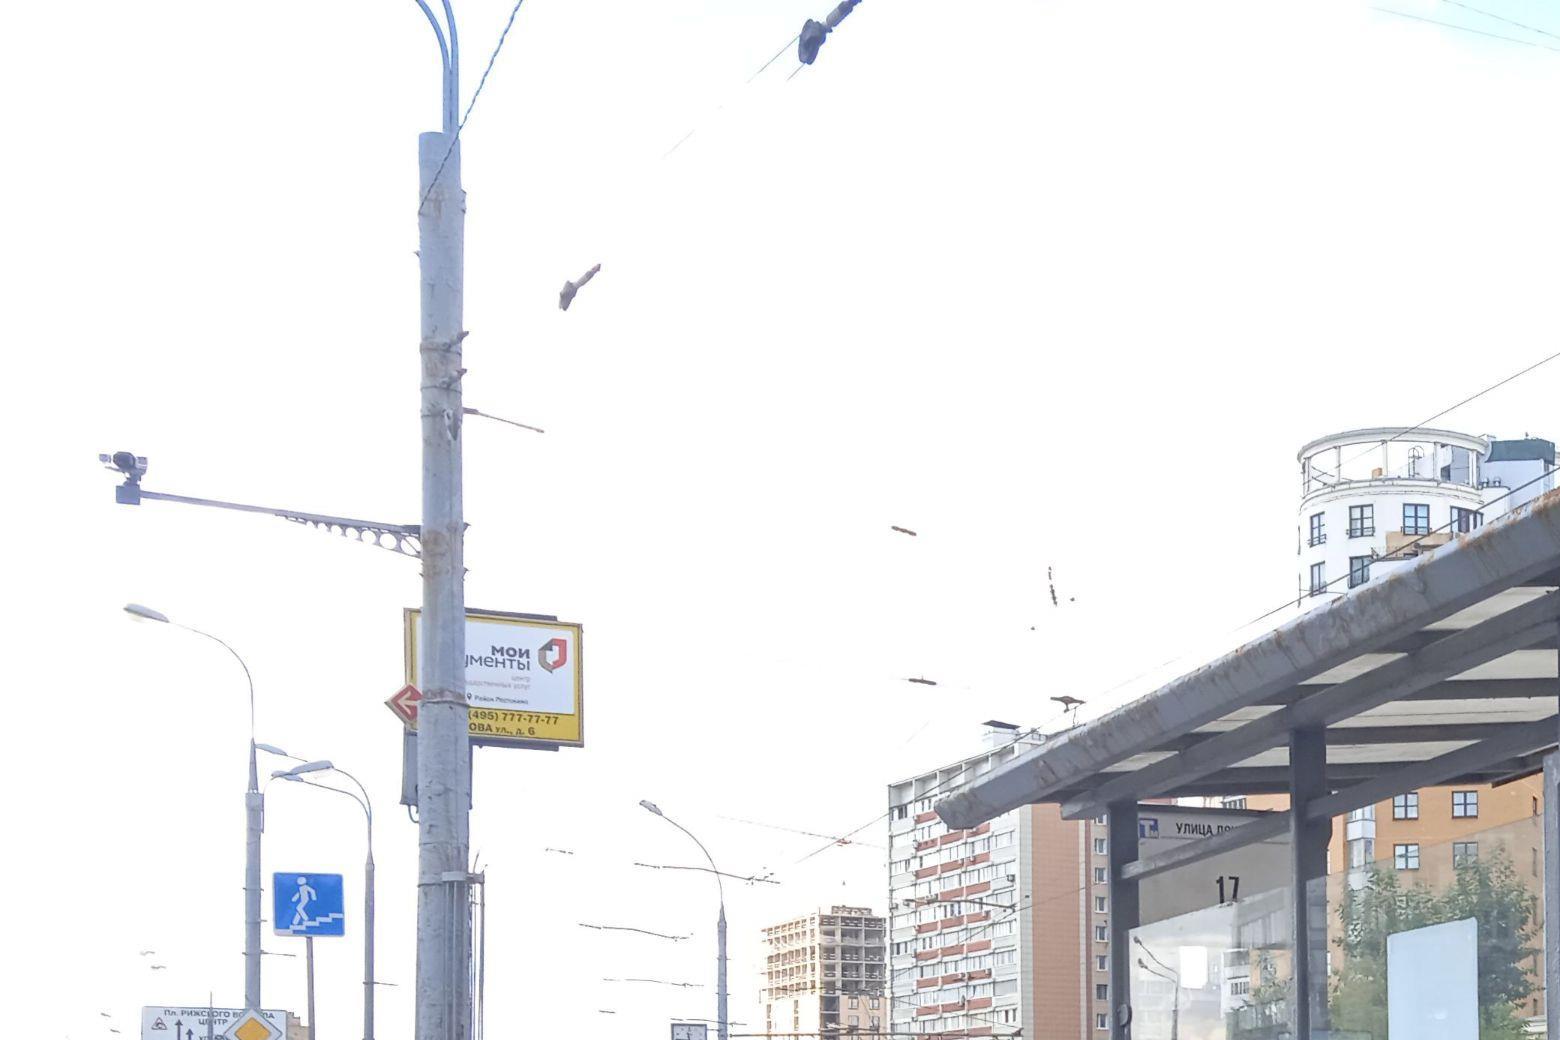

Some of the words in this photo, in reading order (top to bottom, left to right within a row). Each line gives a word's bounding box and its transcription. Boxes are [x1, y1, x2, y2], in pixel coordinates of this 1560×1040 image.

[465, 655, 530, 671] ументы
[501, 712, 559, 725] 777-77-77
[468, 722, 493, 732] ОВА
[1176, 823, 1214, 837] УЛИЦА
[1216, 876, 1240, 904] 17
[181, 1010, 230, 1018] РИЖСОГО
